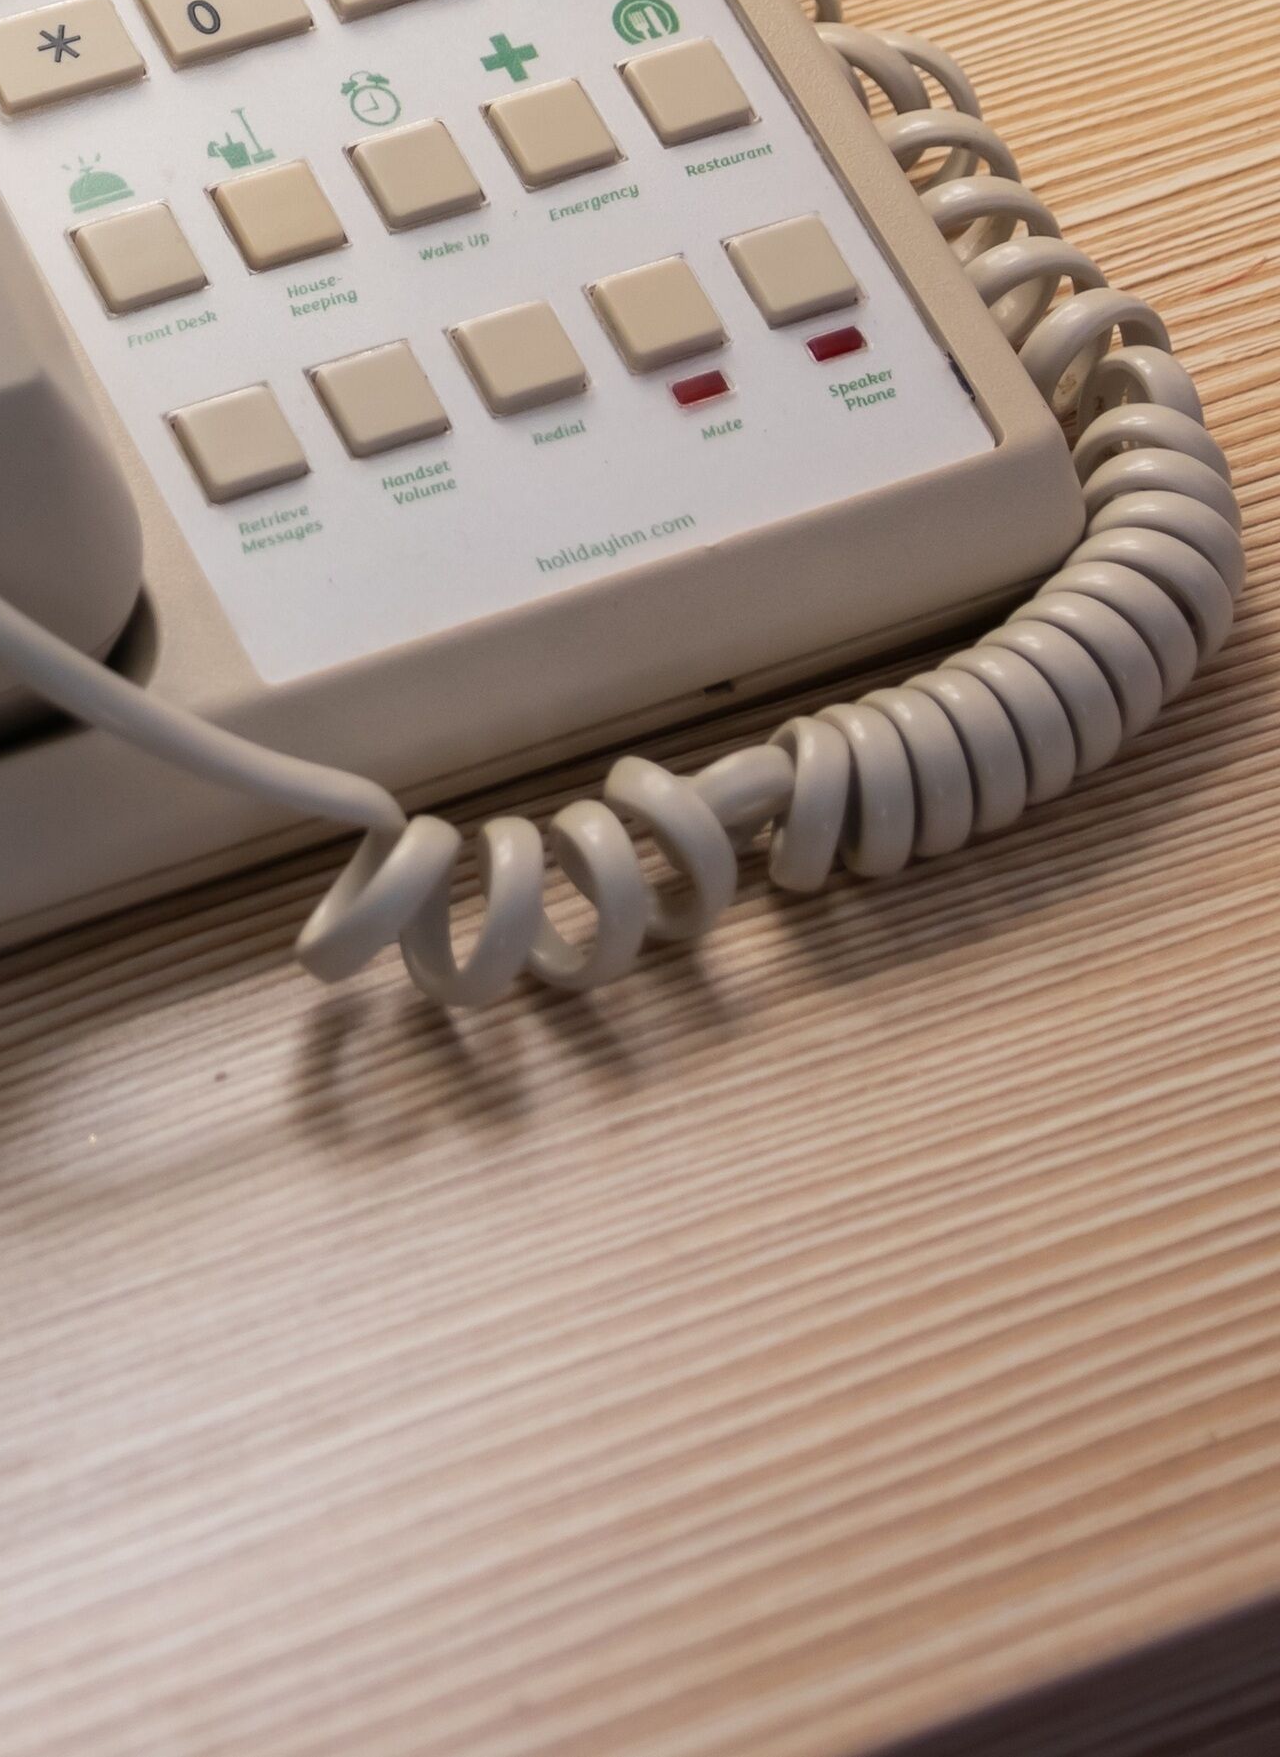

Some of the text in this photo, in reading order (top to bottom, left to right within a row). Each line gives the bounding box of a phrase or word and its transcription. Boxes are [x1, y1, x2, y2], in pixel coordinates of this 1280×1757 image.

[684, 143, 775, 178] Restaurant
[548, 183, 641, 223] Emergency
[418, 232, 491, 262] Wake Up
[286, 274, 344, 300] House-
[290, 288, 360, 318] keeping
[126, 309, 219, 350] Front Desk
[828, 368, 895, 401] Speaker
[843, 384, 898, 412] Phone
[532, 419, 588, 447] Redial
[700, 417, 744, 441] Mute
[381, 459, 452, 491] Handset
[393, 476, 458, 507] Volume
[237, 504, 311, 537] Retrieve
[241, 518, 325, 556] Messages
[535, 511, 698, 575] holidayinn.com
